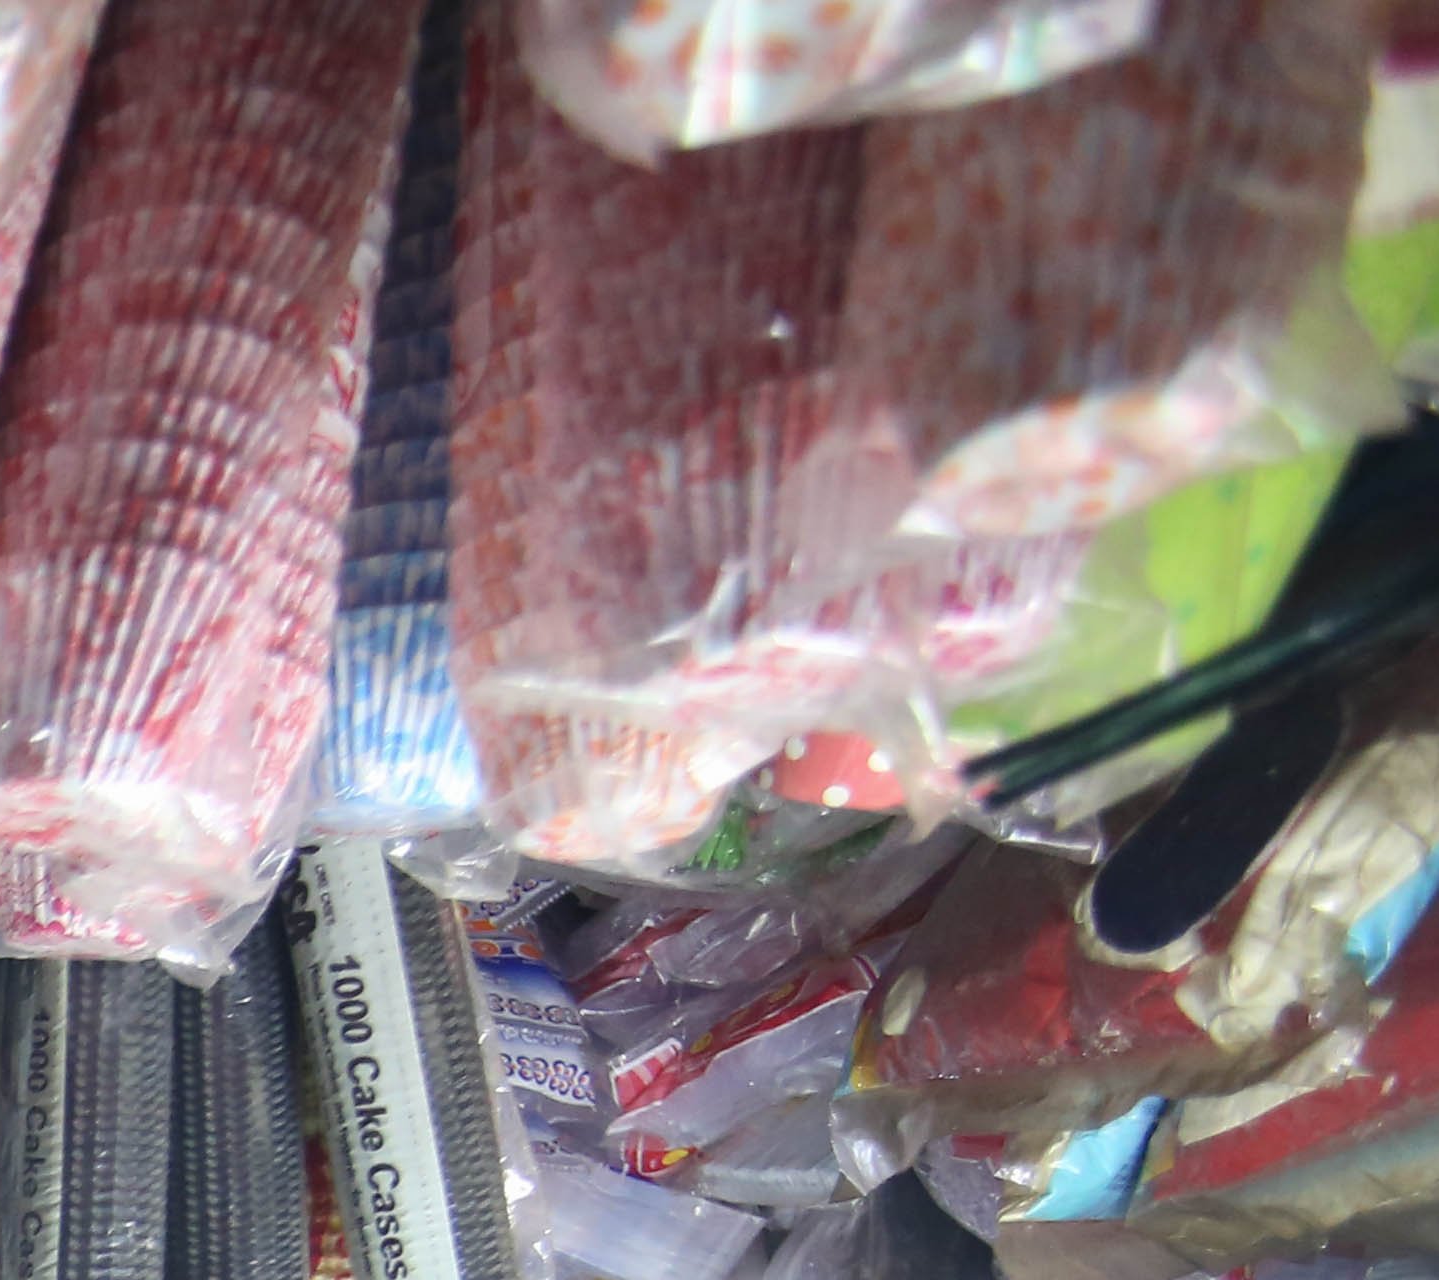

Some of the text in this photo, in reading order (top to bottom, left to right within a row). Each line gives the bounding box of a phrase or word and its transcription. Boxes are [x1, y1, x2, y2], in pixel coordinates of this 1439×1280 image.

[329, 954, 374, 1046] 1000
[24, 1011, 51, 1096] 1000
[346, 1054, 384, 1152] Cake
[21, 1106, 48, 1201] Cake
